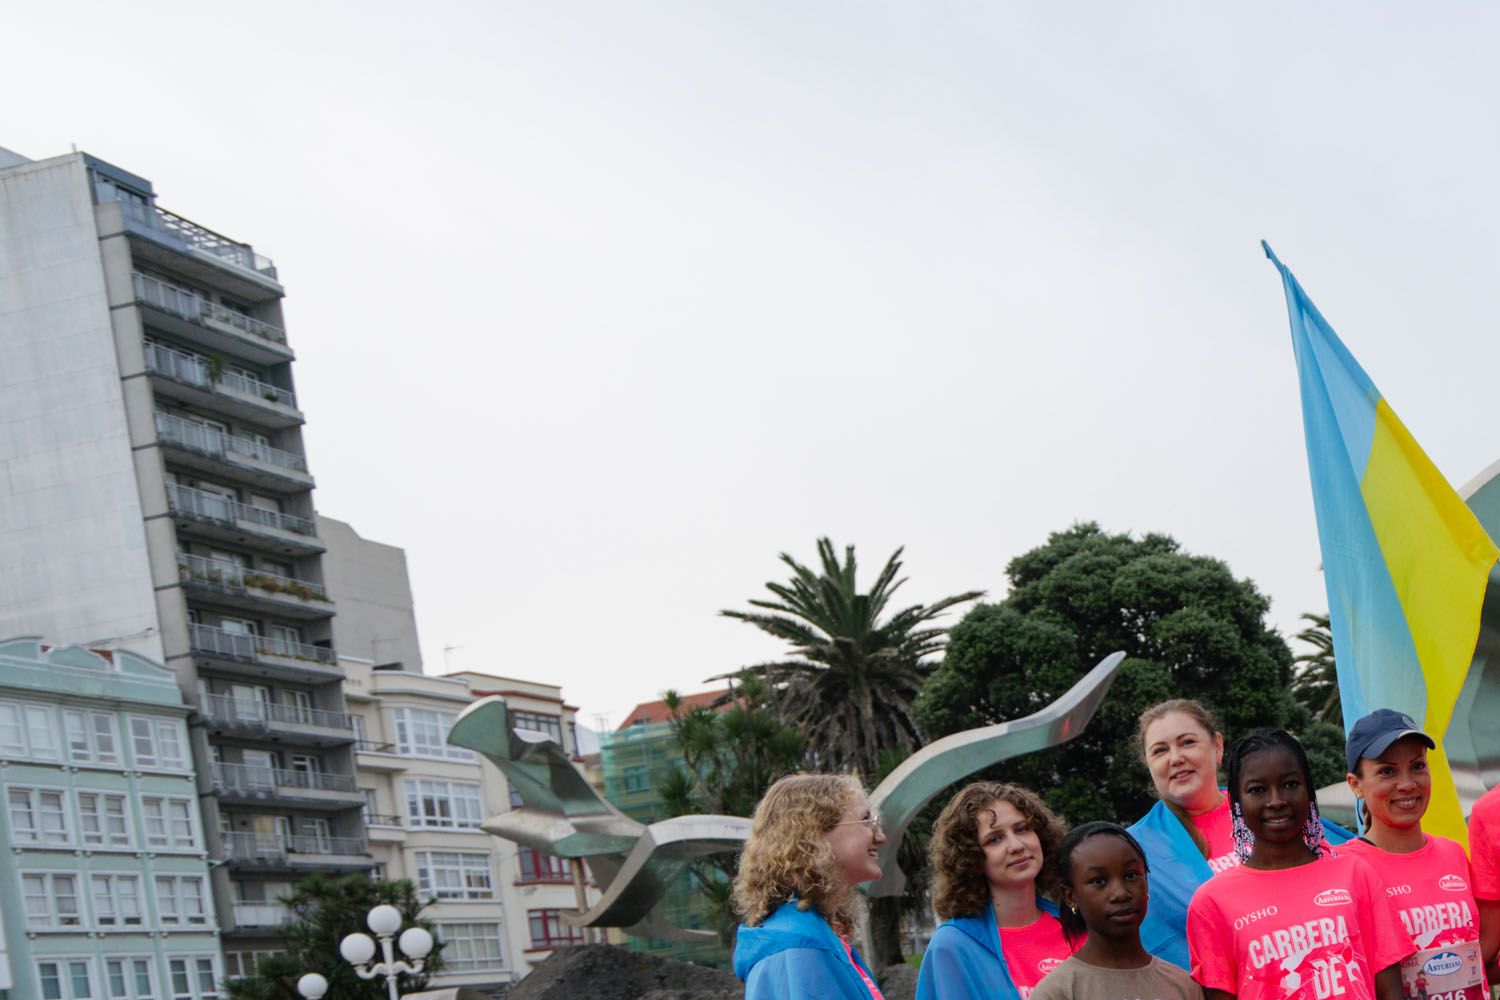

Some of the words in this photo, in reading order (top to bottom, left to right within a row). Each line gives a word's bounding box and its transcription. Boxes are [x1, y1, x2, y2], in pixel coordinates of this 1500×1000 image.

[1386, 884, 1412, 898] SHO
[1234, 905, 1278, 930] OYSHO
[1399, 901, 1474, 936] ARRERA
[1249, 916, 1348, 969] CARRERA
